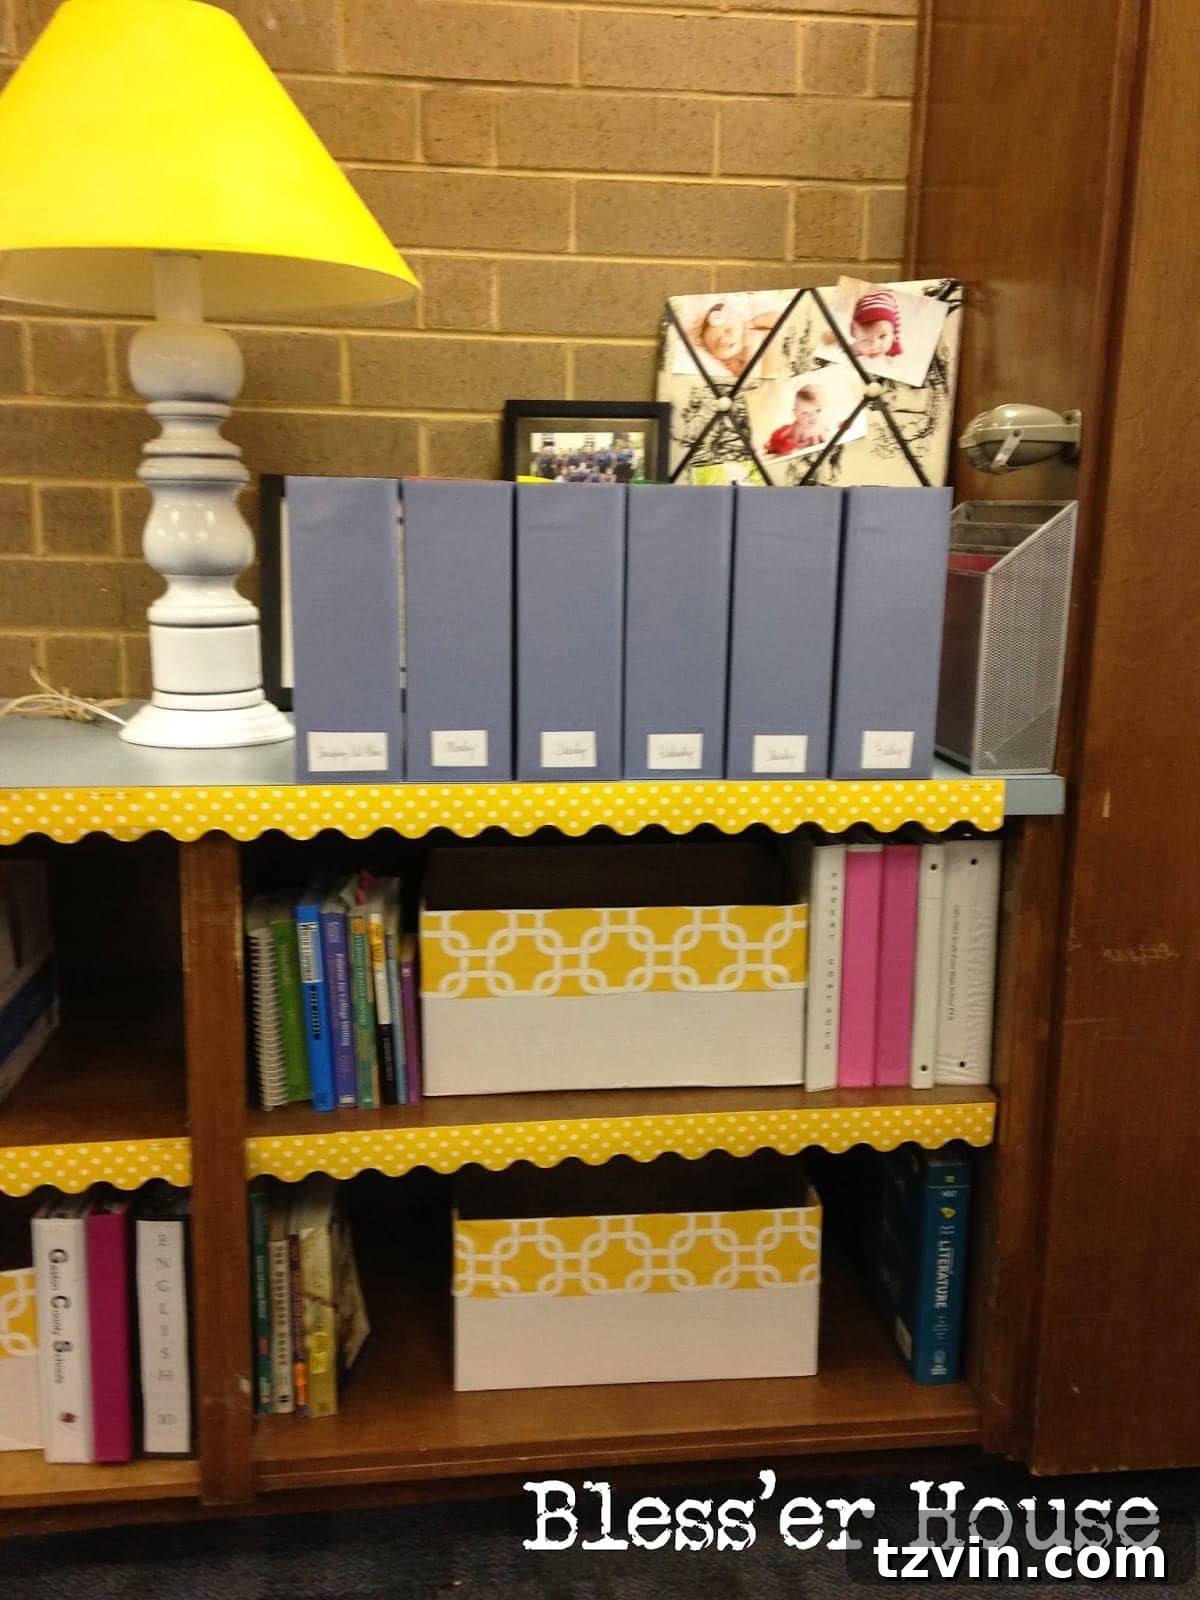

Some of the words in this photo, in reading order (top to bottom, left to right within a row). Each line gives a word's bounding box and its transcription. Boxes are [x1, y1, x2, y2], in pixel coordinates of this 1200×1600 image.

[156, 1233, 174, 1382] ENGLISH
[934, 1240, 952, 1309] LITERATURE
[51, 1295, 72, 1336] County
